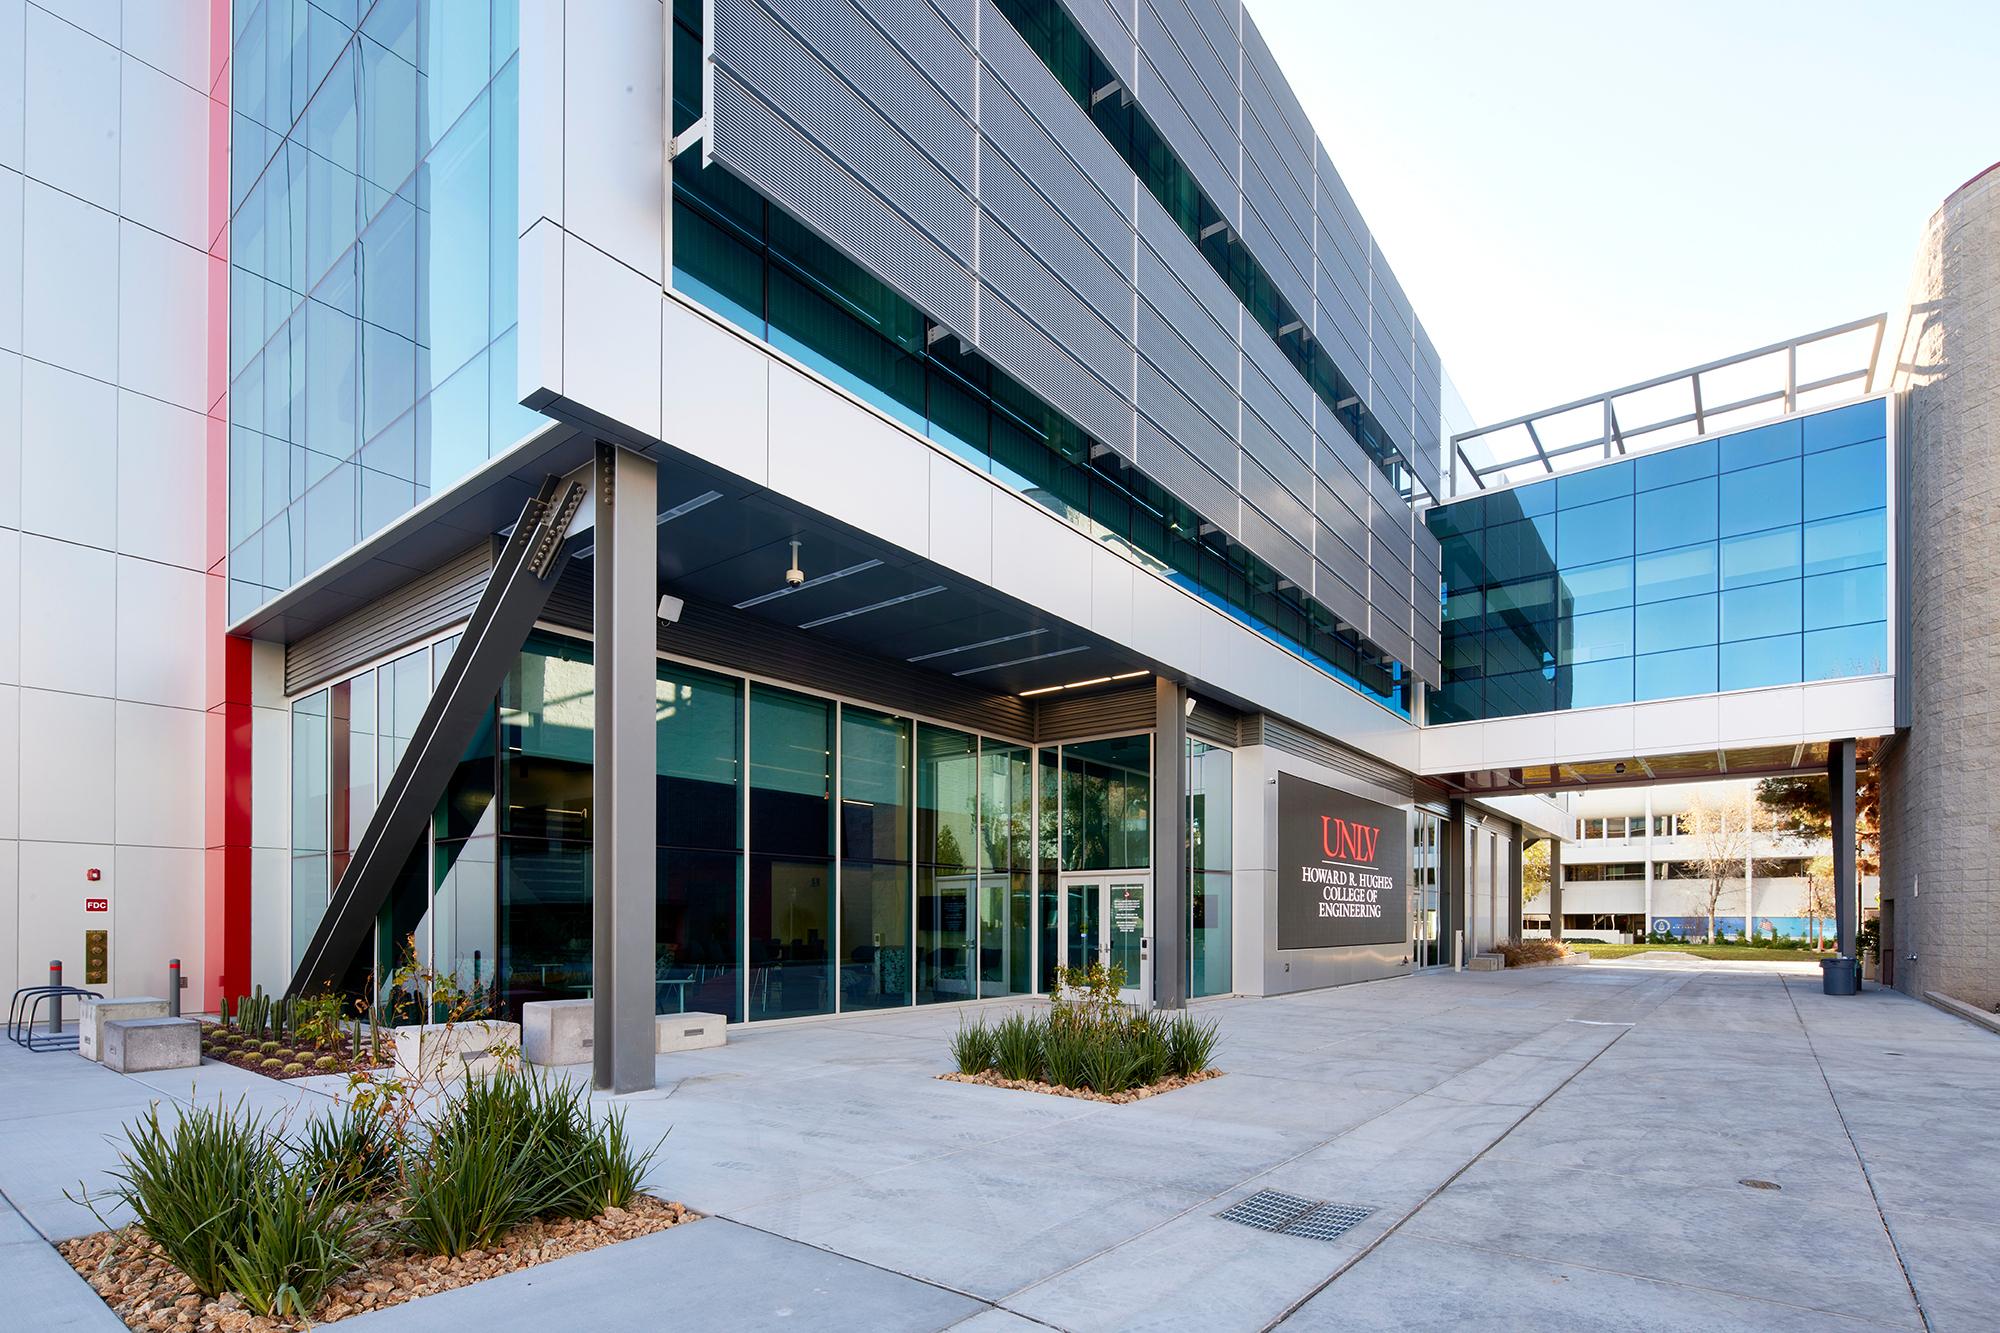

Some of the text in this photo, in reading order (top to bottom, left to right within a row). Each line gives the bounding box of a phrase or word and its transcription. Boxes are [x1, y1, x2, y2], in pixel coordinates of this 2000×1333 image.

[1321, 816, 1380, 862] UNLV
[1302, 867, 1393, 889] HOWARD R. HUGHES
[1323, 886, 1378, 902] COLLEGE OF
[1319, 902, 1381, 918] ENGINEERING
